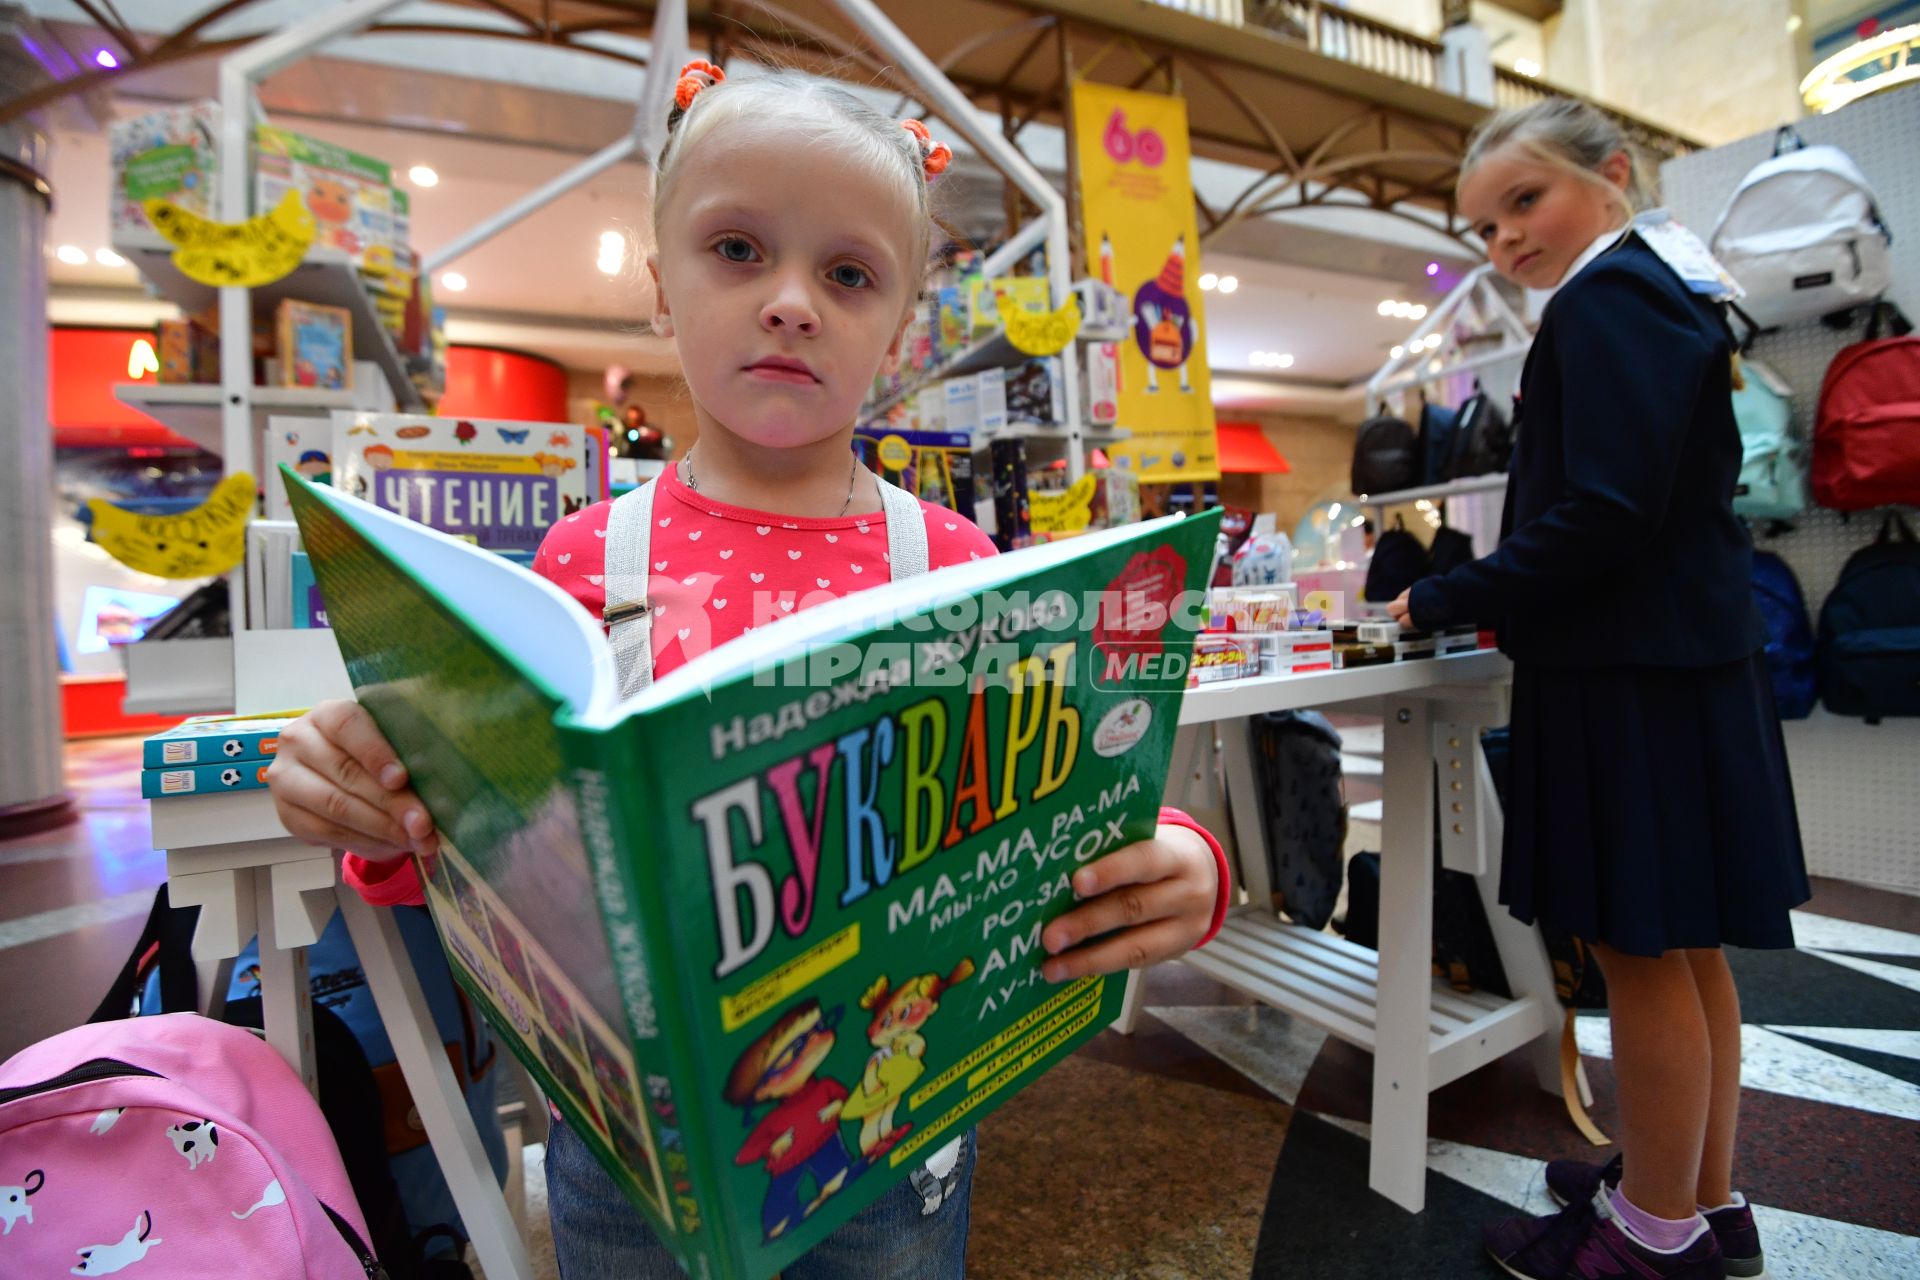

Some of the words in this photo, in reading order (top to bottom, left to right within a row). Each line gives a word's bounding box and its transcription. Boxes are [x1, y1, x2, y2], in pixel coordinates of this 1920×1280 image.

[1103, 106, 1167, 169] 60
[384, 475, 550, 528] ЧТЕНИЕ
[711, 657, 911, 760] Надежда
[692, 641, 1082, 979] БУКВАРЬ
[1052, 774, 1141, 838] РА-МА
[888, 827, 1038, 934] МА-МА
[930, 869, 1019, 933] МЫ-ЛО
[1000, 987, 1098, 1063] ОРИГИНАЛЬНОЙ
[917, 1038, 997, 1101] СОЧЕТАНИЕ
[899, 1059, 1025, 1157] ЛОГОПЕДИЧЕСКОЙ
